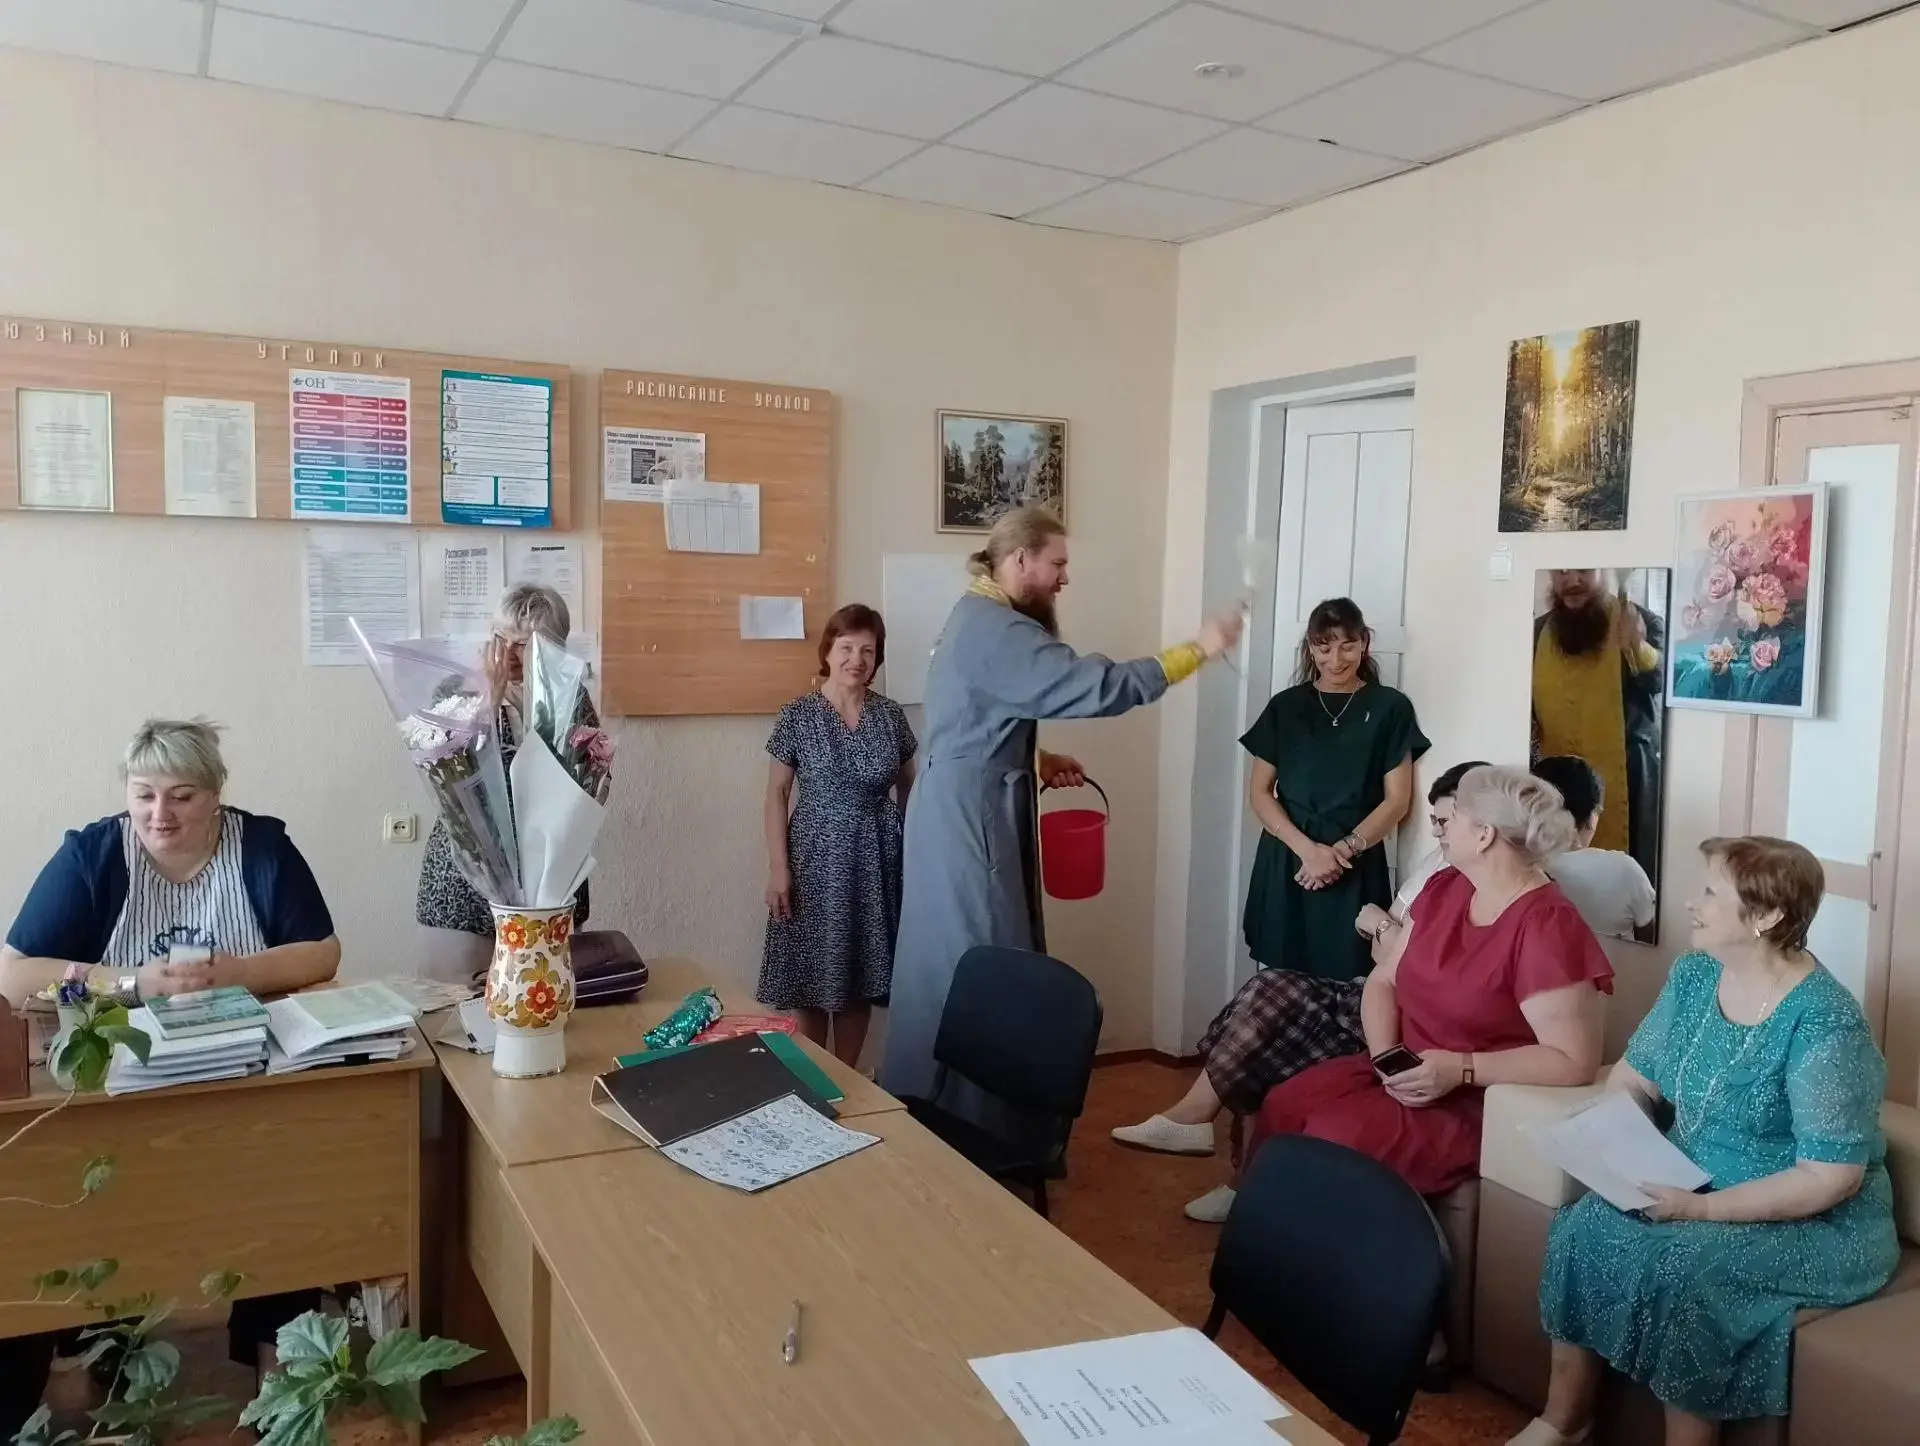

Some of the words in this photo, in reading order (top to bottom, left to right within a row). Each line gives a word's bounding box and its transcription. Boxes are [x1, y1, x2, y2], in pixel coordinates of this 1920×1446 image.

[257, 343, 384, 369] УГОЛОК
[626, 379, 727, 403] РАСПИСАНИЕ
[755, 391, 811, 412] УРОКОВ
